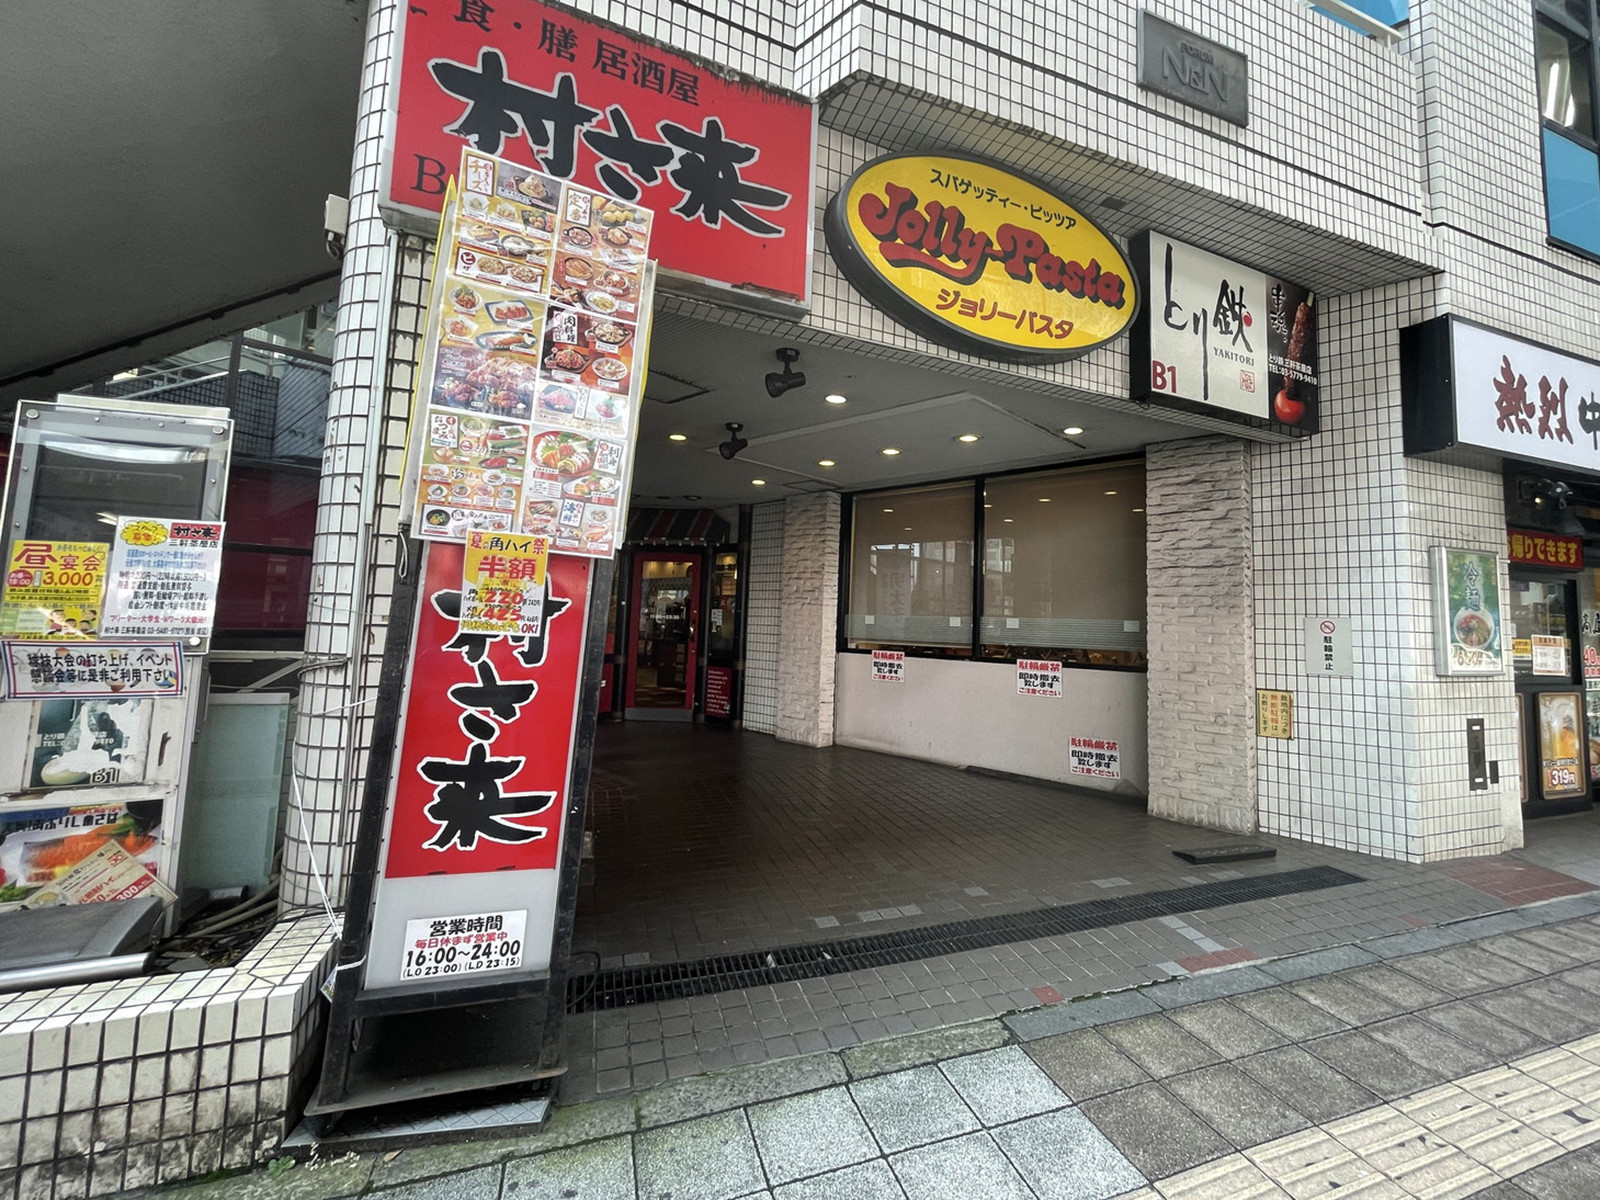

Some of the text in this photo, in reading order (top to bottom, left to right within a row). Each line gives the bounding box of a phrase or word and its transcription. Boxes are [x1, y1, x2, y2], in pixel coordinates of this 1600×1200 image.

[427, 45, 791, 238] 村さ来
[858, 181, 1126, 310] Jolly-Pasta
[936, 287, 1075, 339] ジョリーパスタ
[1213, 346, 1255, 366] YAKITORI
[1152, 360, 1177, 394] B1
[471, 532, 545, 555] 夏の角ハイ祭
[1507, 534, 1578, 564] 帰りできます
[478, 556, 537, 580] 半額
[1323, 635, 1334, 671] 駐輪禁止
[1018, 660, 1062, 672] 駐輪厳禁
[1018, 672, 1061, 683] 即時撤去
[1023, 679, 1055, 689] 致します
[1018, 687, 1062, 697] ご注意ください
[1070, 737, 1118, 751] 駐輪厳禁
[1071, 750, 1118, 763] 即時撤去
[1077, 758, 1111, 769] 致します
[1071, 765, 1119, 778] ご注意ください
[430, 915, 503, 937] 営業時間
[415, 931, 508, 949] 毎日休まず営業中
